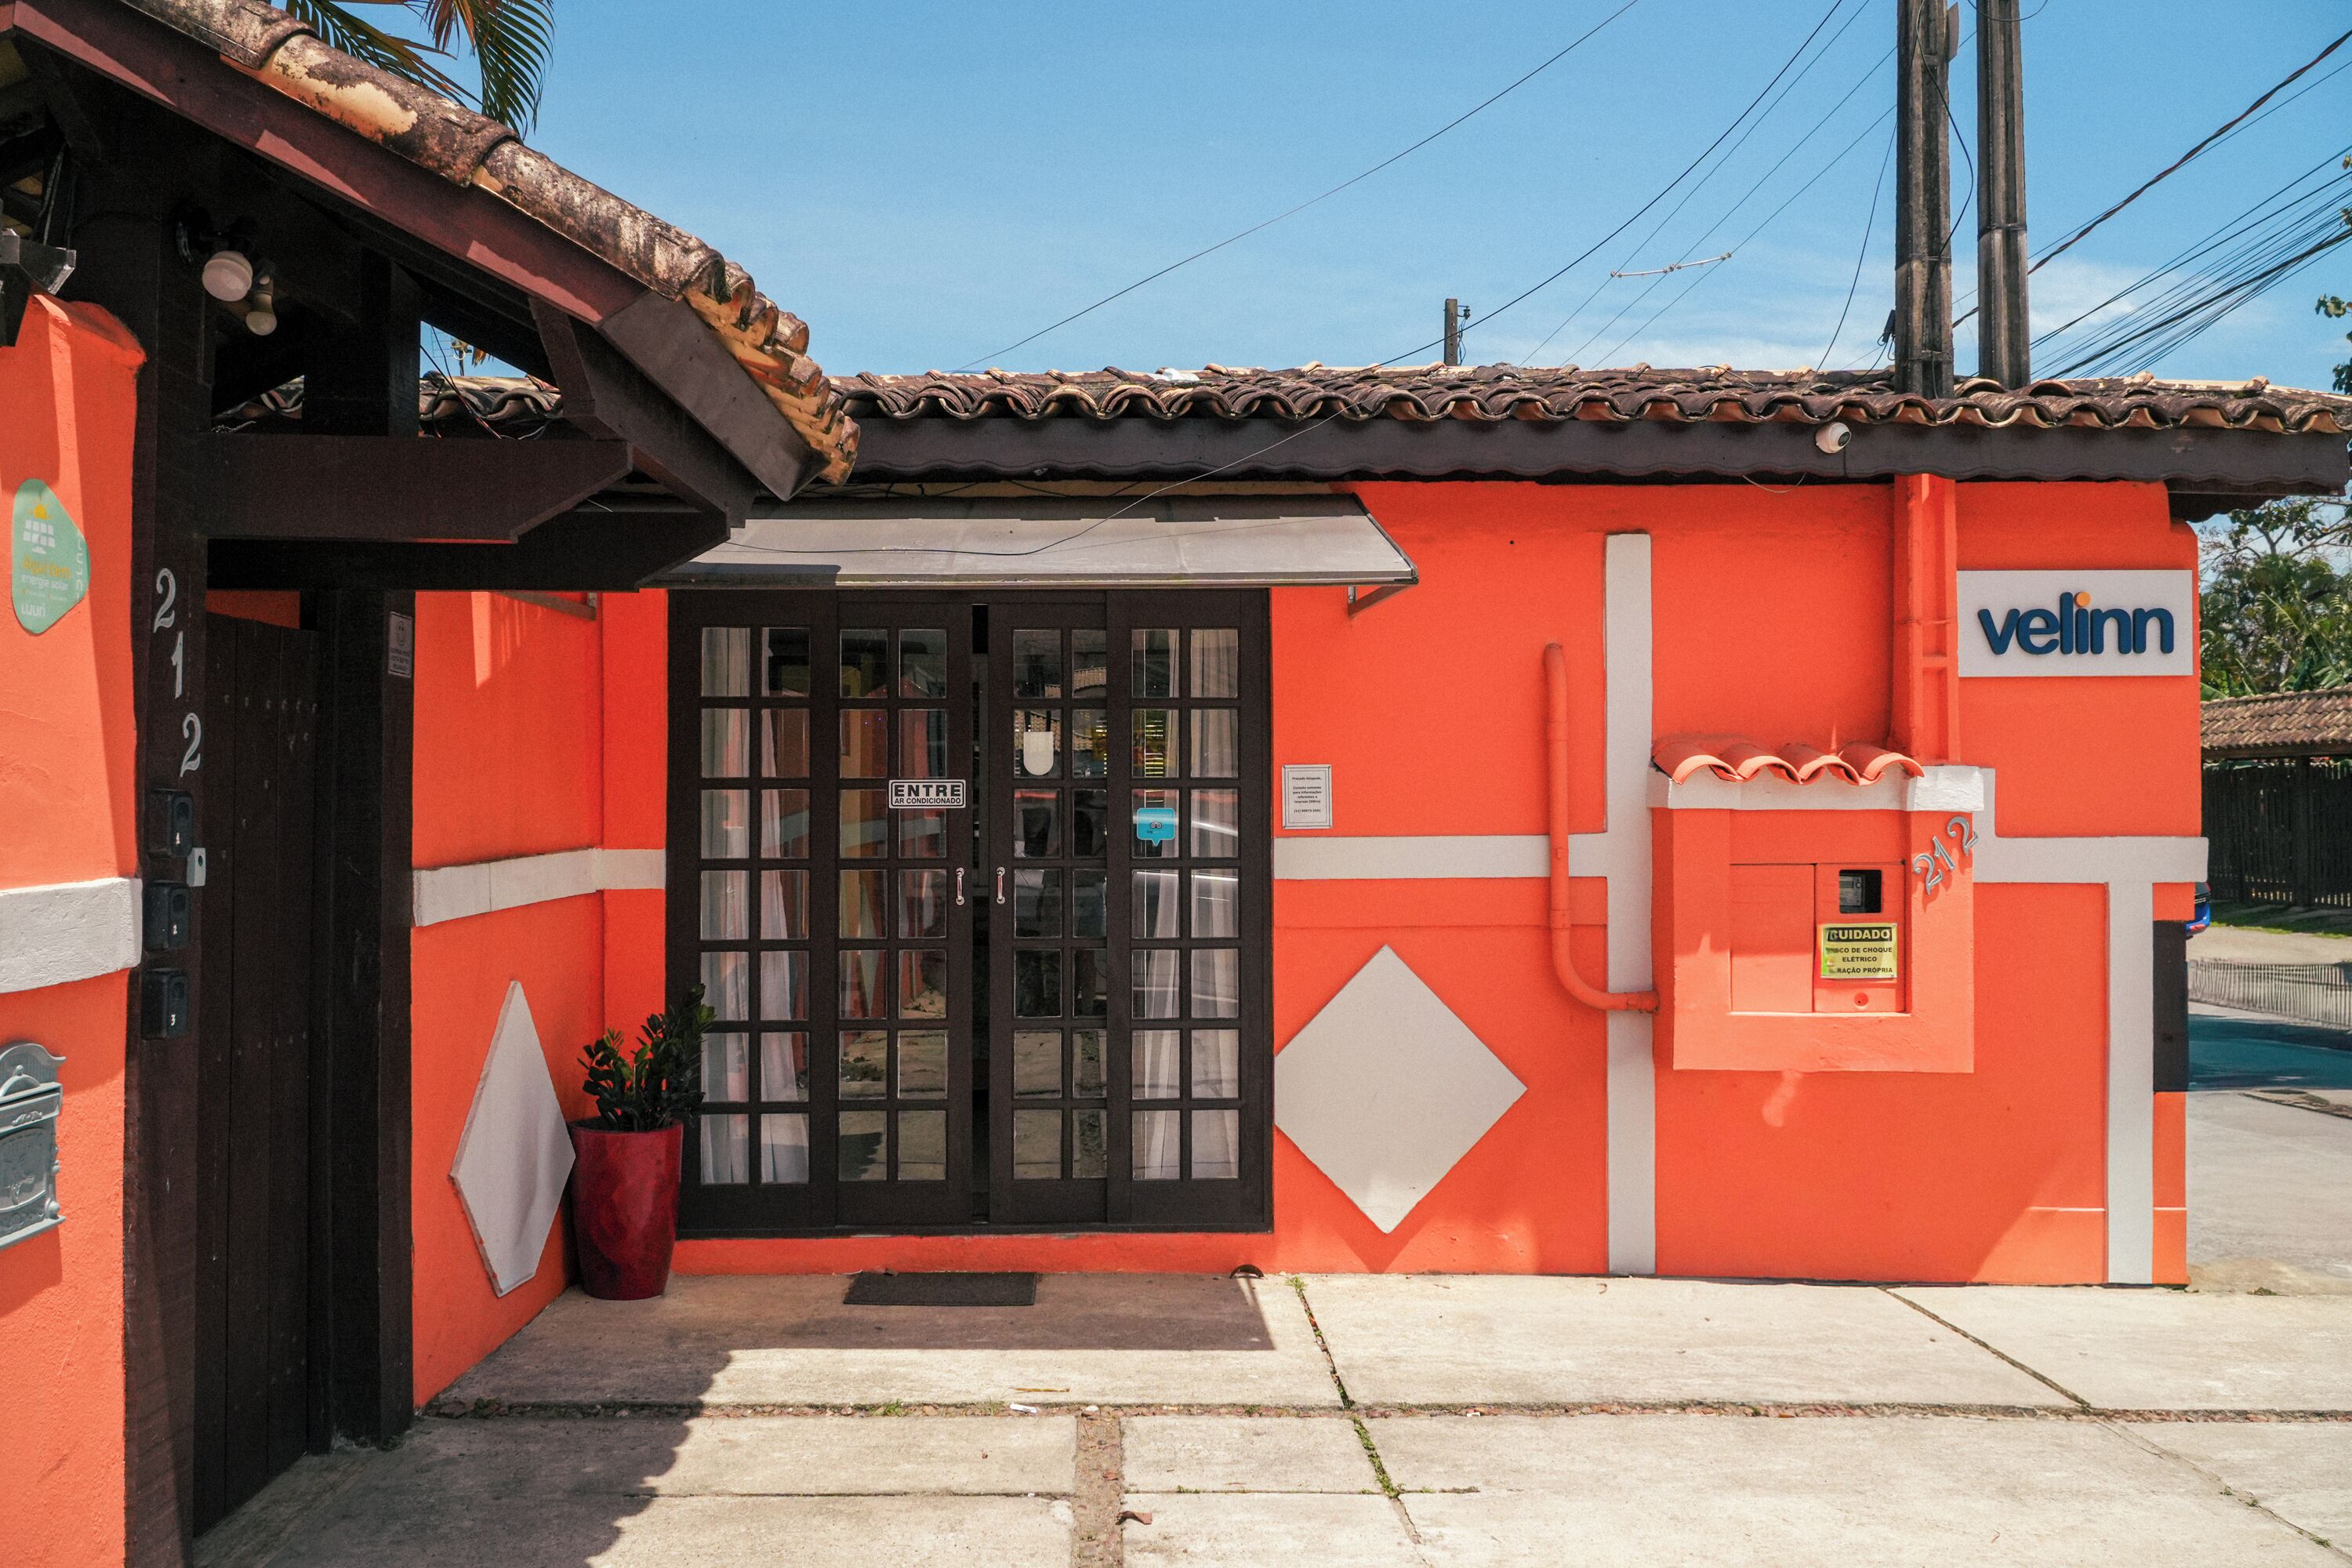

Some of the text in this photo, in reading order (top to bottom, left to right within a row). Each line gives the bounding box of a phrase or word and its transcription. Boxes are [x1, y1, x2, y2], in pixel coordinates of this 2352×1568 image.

[21, 575, 69, 590] energia solar
[1977, 591, 2175, 655] velinn
[154, 568, 201, 778] 212
[894, 784, 960, 797] ENTRE
[1913, 816, 1981, 896] 212
[1829, 929, 1891, 940] CUIDADO
